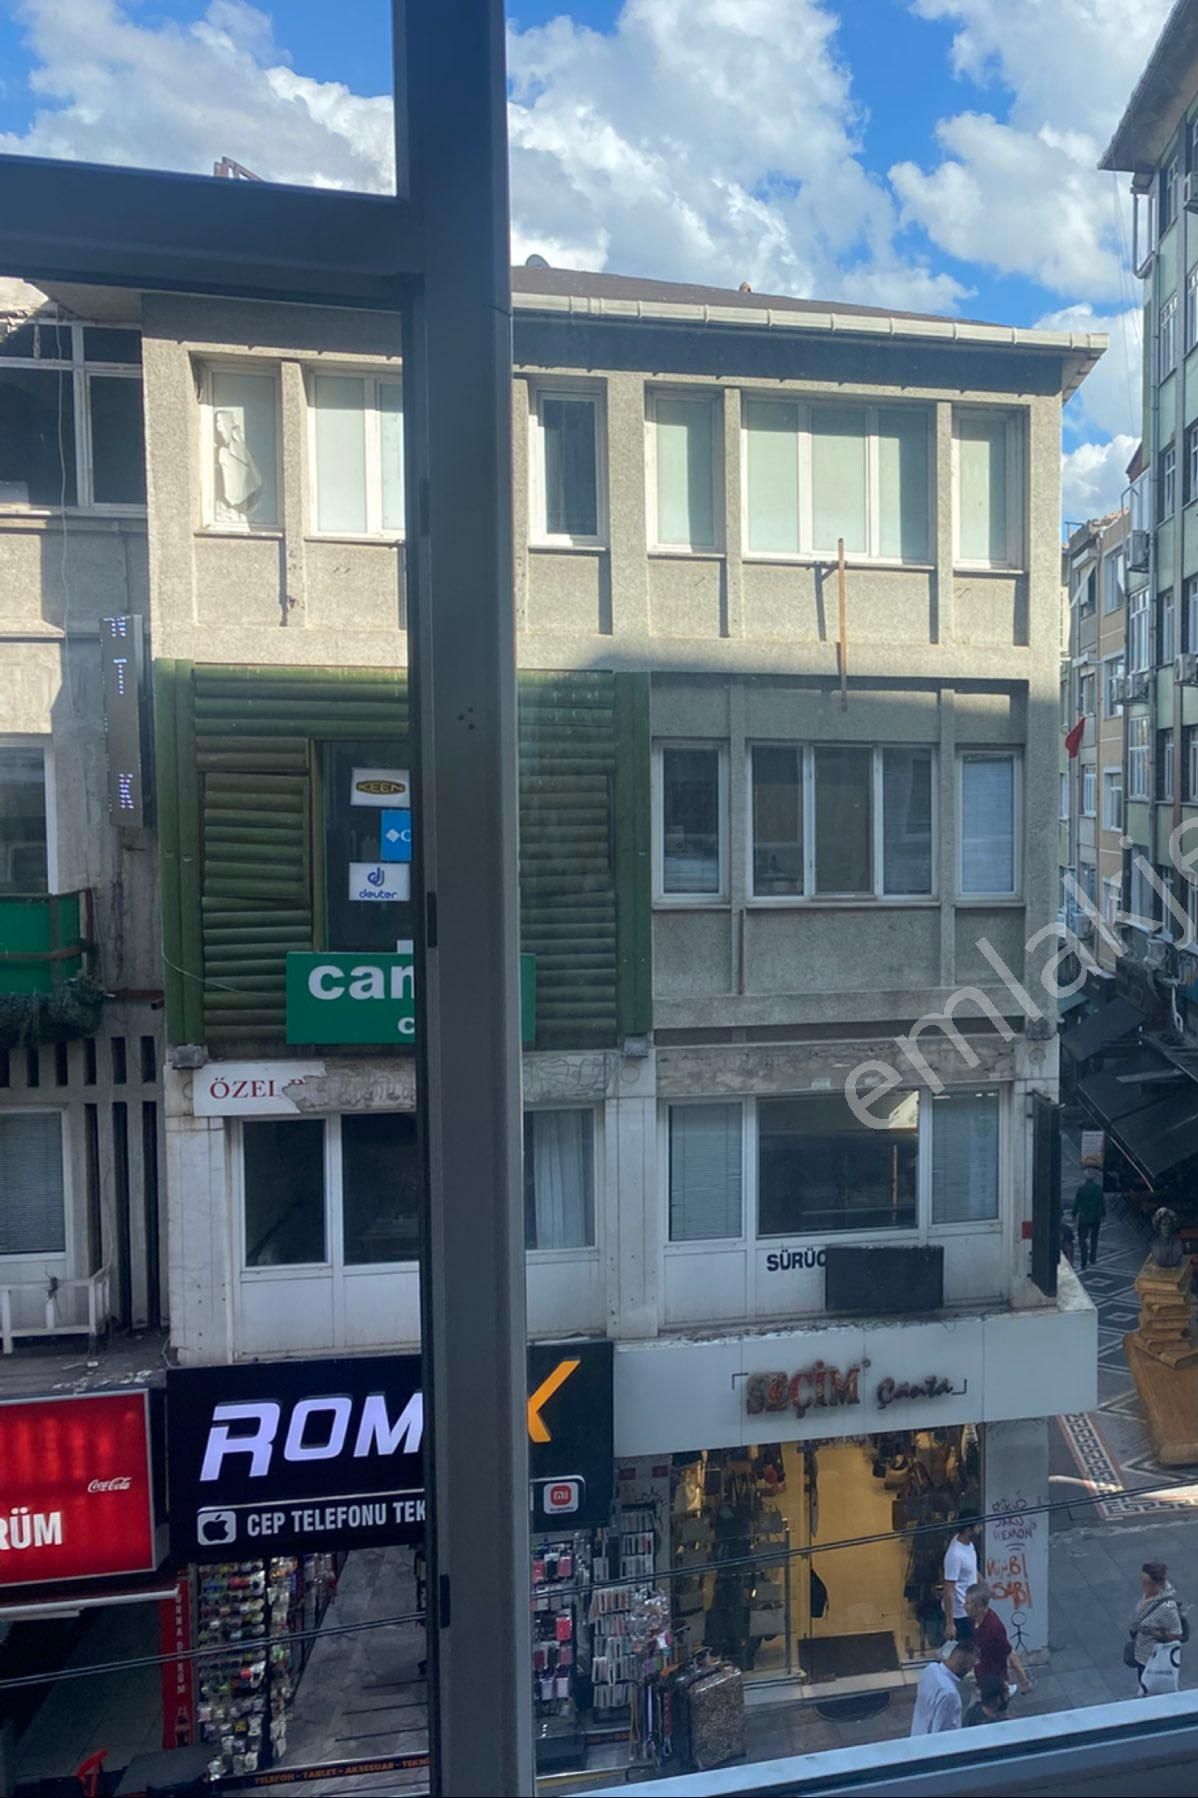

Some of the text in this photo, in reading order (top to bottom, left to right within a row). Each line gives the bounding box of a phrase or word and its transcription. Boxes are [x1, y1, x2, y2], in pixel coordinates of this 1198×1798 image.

[357, 781, 404, 794] KEEN
[359, 889, 397, 899] deuter
[209, 1077, 280, 1099] ÖZEL
[746, 1360, 860, 1419] SEÇİM
[247, 1514, 284, 1537] CEP
[291, 1504, 387, 1532] TELEFONU
